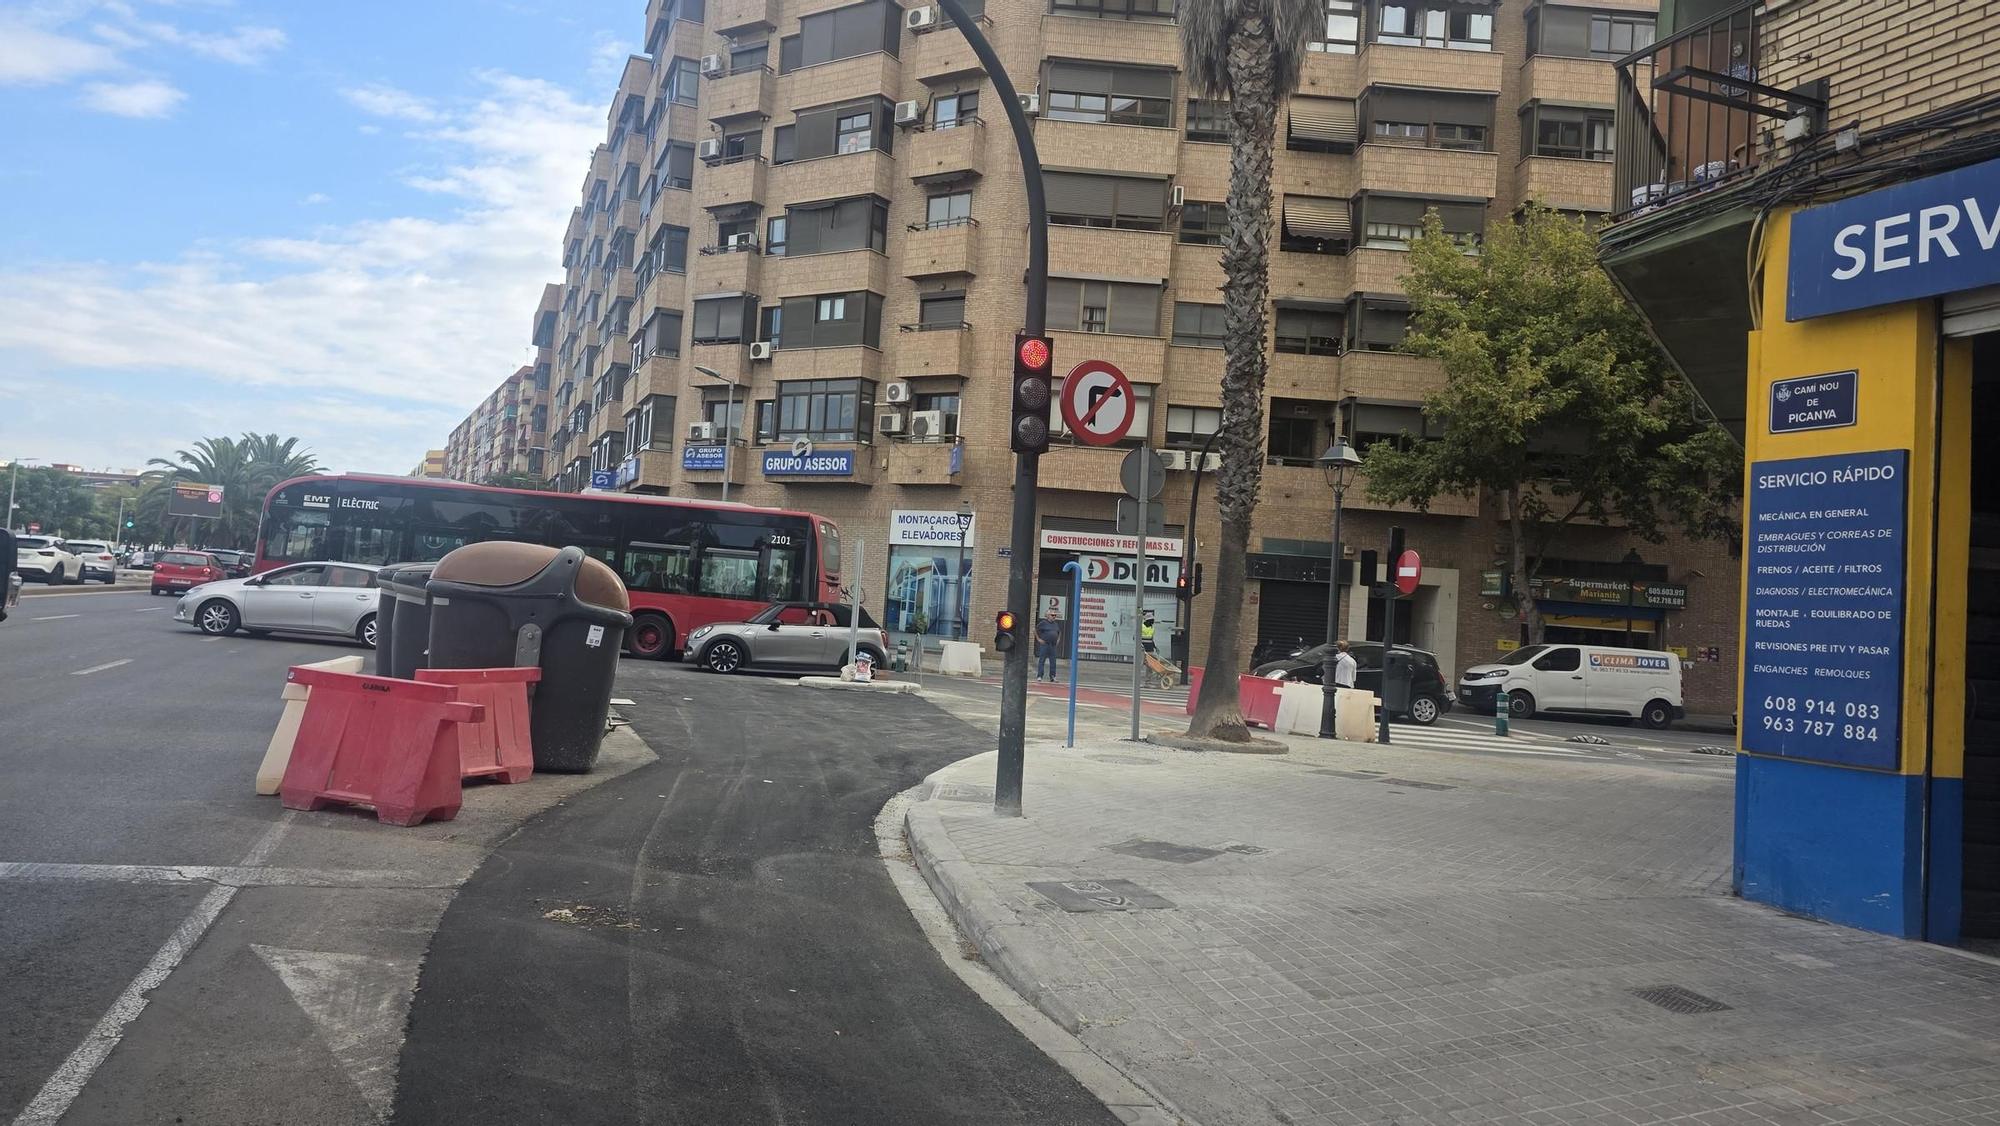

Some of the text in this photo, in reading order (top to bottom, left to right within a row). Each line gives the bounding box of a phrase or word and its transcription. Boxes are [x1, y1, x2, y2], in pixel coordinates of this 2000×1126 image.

[1831, 197, 2000, 281] SERV
[1794, 382, 1839, 395] CAMÍ NOU
[1806, 398, 1819, 407] DE
[1788, 408, 1837, 423] PICANYA
[766, 457, 848, 471] GRUPO ASESOR
[1759, 465, 1895, 489] SERVICIO RÁPIDO
[303, 494, 380, 510] EMT ELÈCTRIC
[898, 515, 969, 526] MONTACARGAS
[1759, 508, 1869, 521] MECÁNICA EN GENERAL
[771, 535, 791, 545] 2101
[901, 530, 963, 541] ELEVADORES
[1758, 529, 1893, 542] EMBRAGUES Y CORREAS DE
[1047, 534, 1115, 548] CONSTRUCCIONES
[1116, 540, 1121, 548] Y
[1122, 540, 1163, 551] REFMAS
[1757, 543, 1826, 554] DISTRIBUCIÓN
[1757, 565, 1793, 575] FRENOS
[1801, 565, 1835, 574] ACEITE
[1844, 564, 1882, 574] FILTROS
[1569, 578, 1627, 591] Supermarket
[1755, 587, 1799, 596] DIAGNOSIS
[1808, 585, 1893, 597] ELECTROMECÁNICA
[1580, 589, 1621, 599] Marianita
[1755, 609, 1799, 618] MONTAJE
[1810, 609, 1876, 619] EQUILIBRADO
[1878, 611, 1892, 620] DE
[1755, 619, 1791, 629] RUEDAS
[1755, 641, 1890, 655] REVISIONES PRE ITV Y PASAR
[1604, 657, 1667, 667] CLIMA JOVER
[1753, 664, 1871, 680] ENGANCHES REMOLQUES
[1764, 695, 1880, 720] 608 914 083
[1763, 715, 1878, 742] 963 787 884
